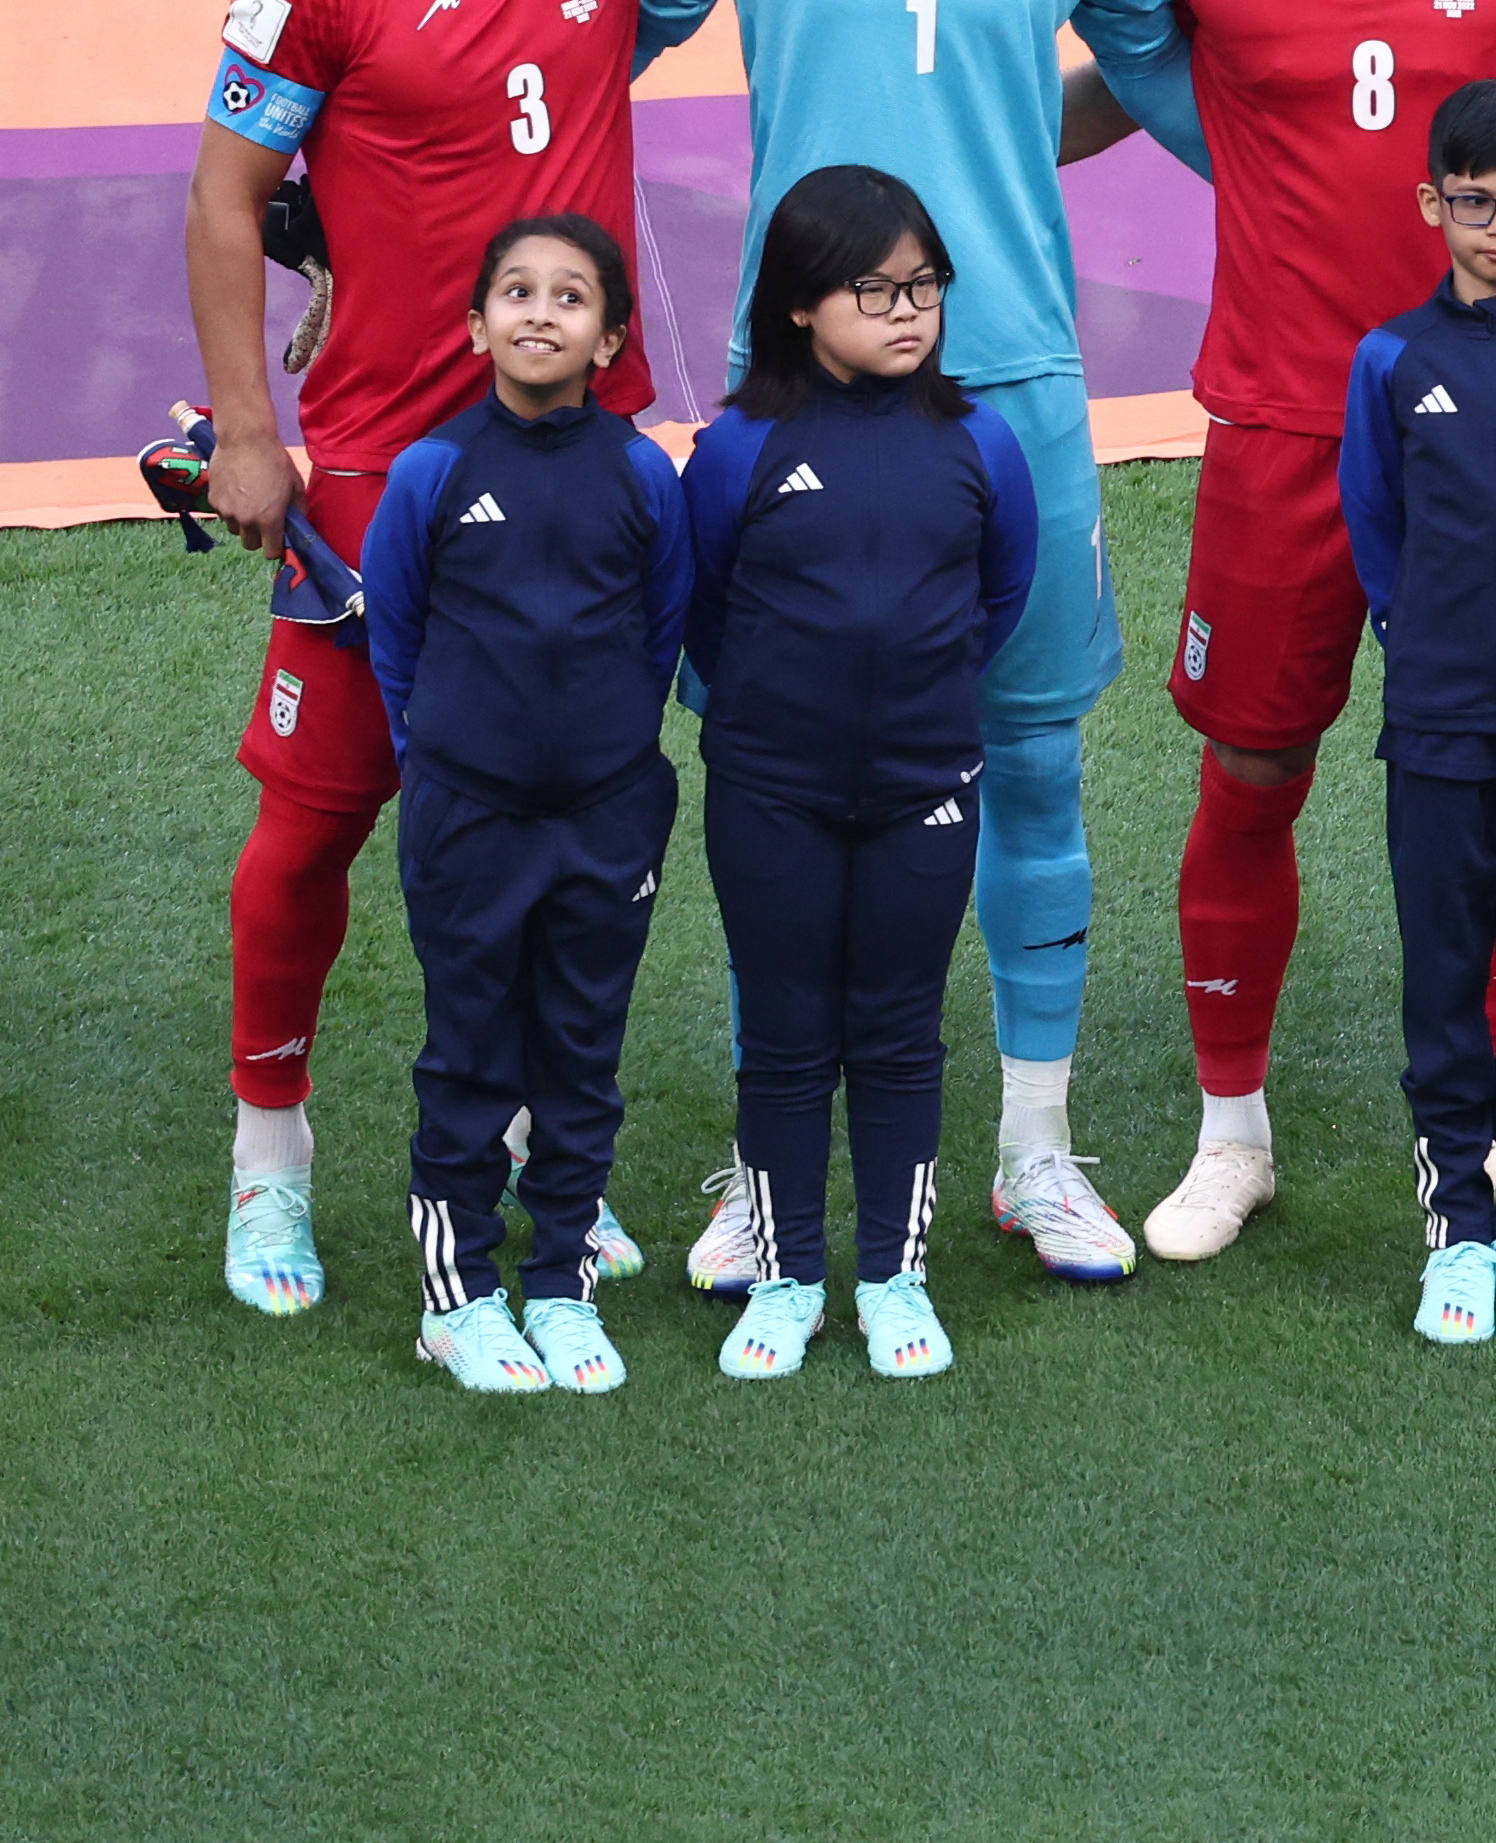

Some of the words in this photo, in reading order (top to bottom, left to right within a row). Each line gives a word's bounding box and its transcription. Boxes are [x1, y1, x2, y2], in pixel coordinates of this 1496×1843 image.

[264, 102, 308, 128] UNITES
[506, 63, 551, 155] 3
[1352, 39, 1395, 131] 8
